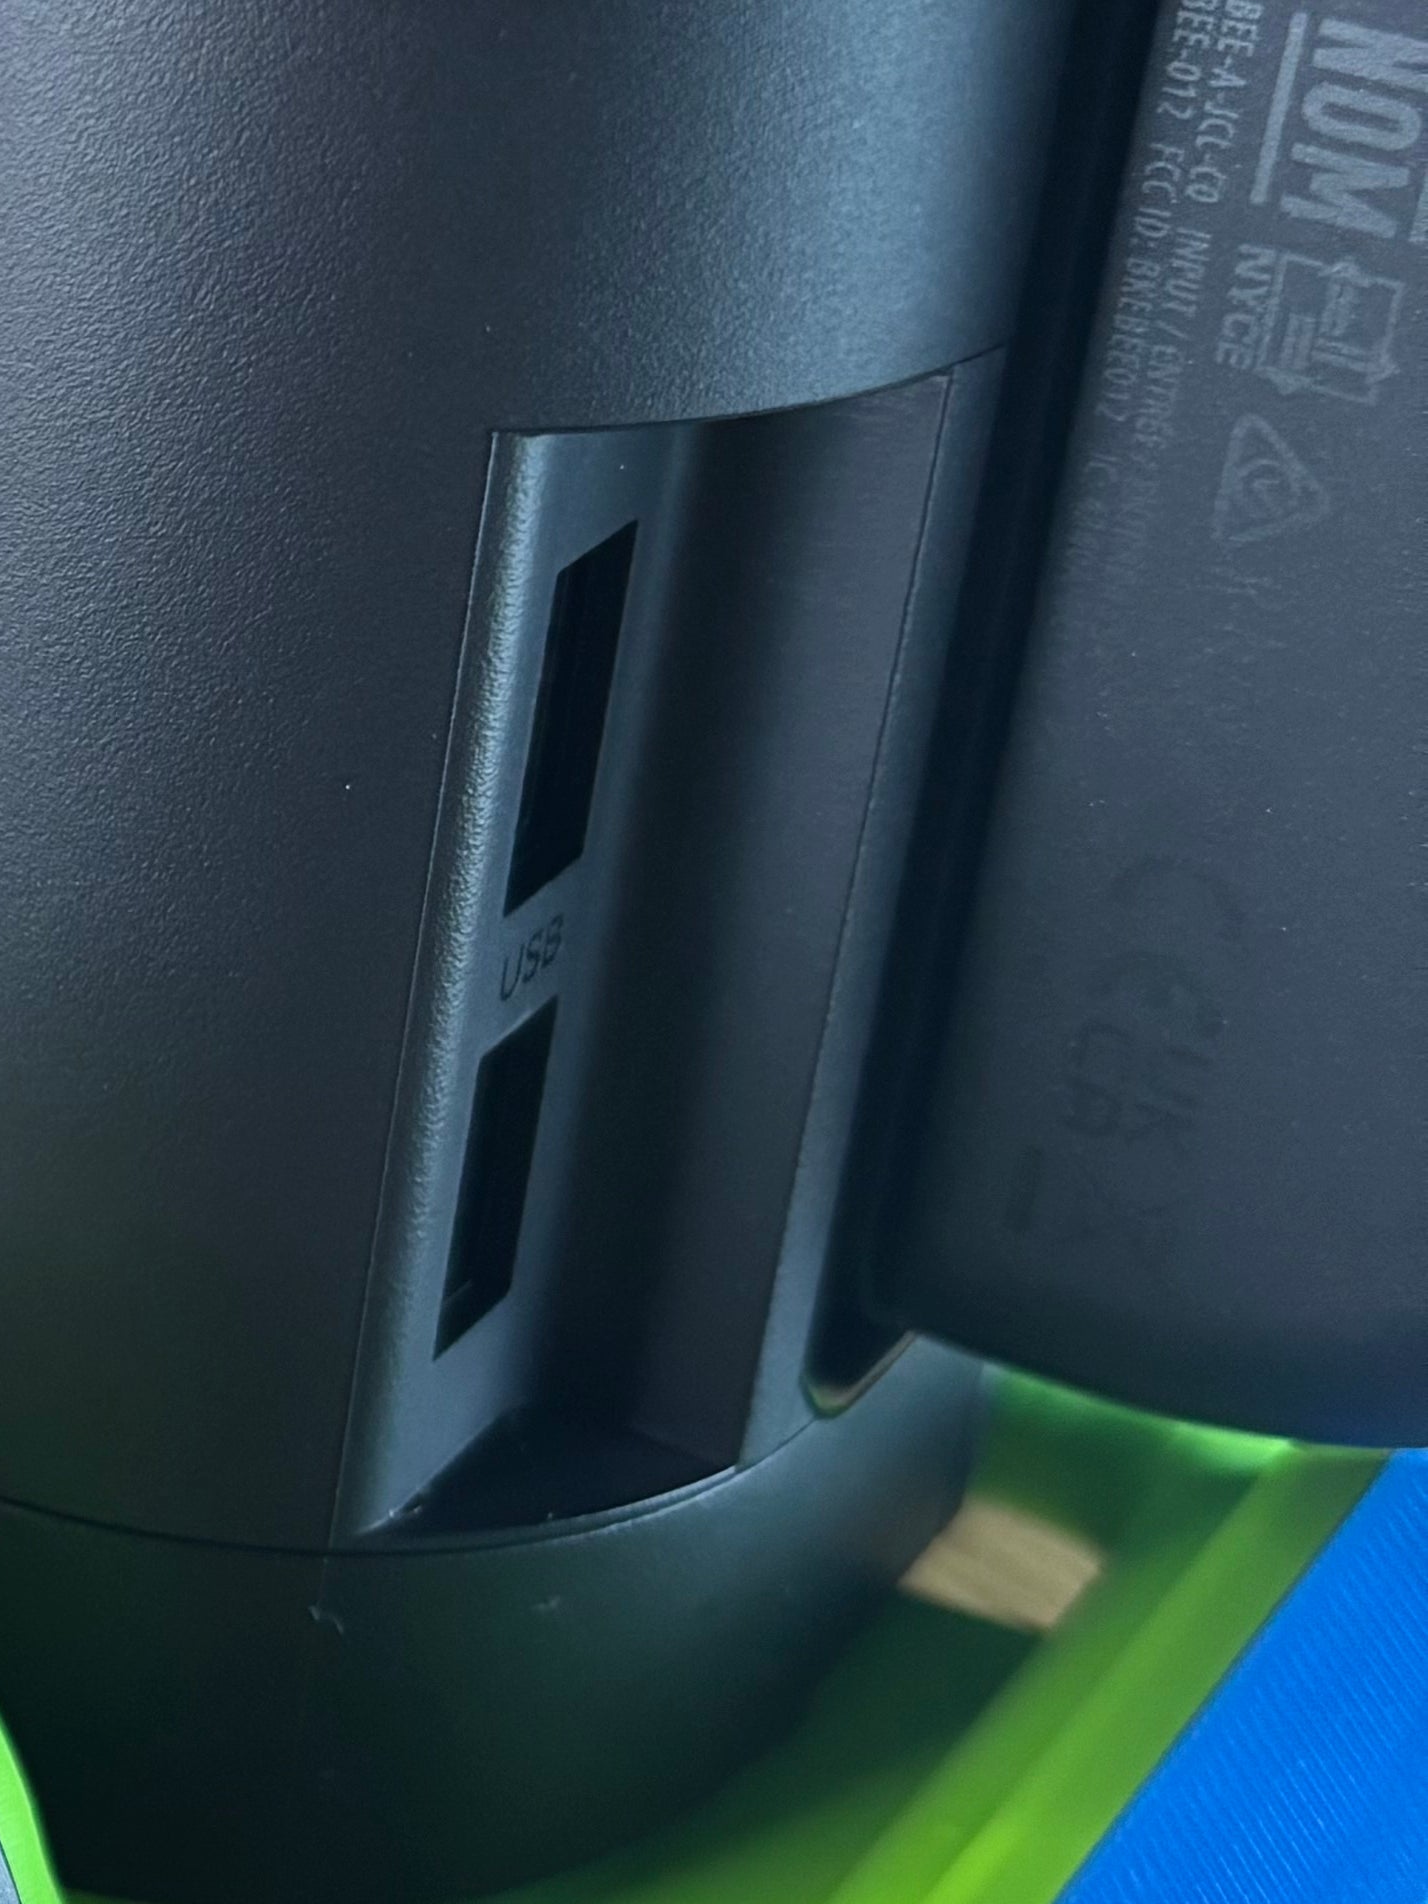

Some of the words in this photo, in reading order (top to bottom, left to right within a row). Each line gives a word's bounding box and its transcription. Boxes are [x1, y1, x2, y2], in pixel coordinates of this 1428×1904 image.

[1141, 140, 1185, 200] FCC
[1278, 17, 1428, 239] NOM
[1131, 205, 1172, 252] ID:
[1162, 227, 1213, 316] INPUT
[1214, 245, 1276, 371] NYCE
[499, 912, 564, 1002] USB
